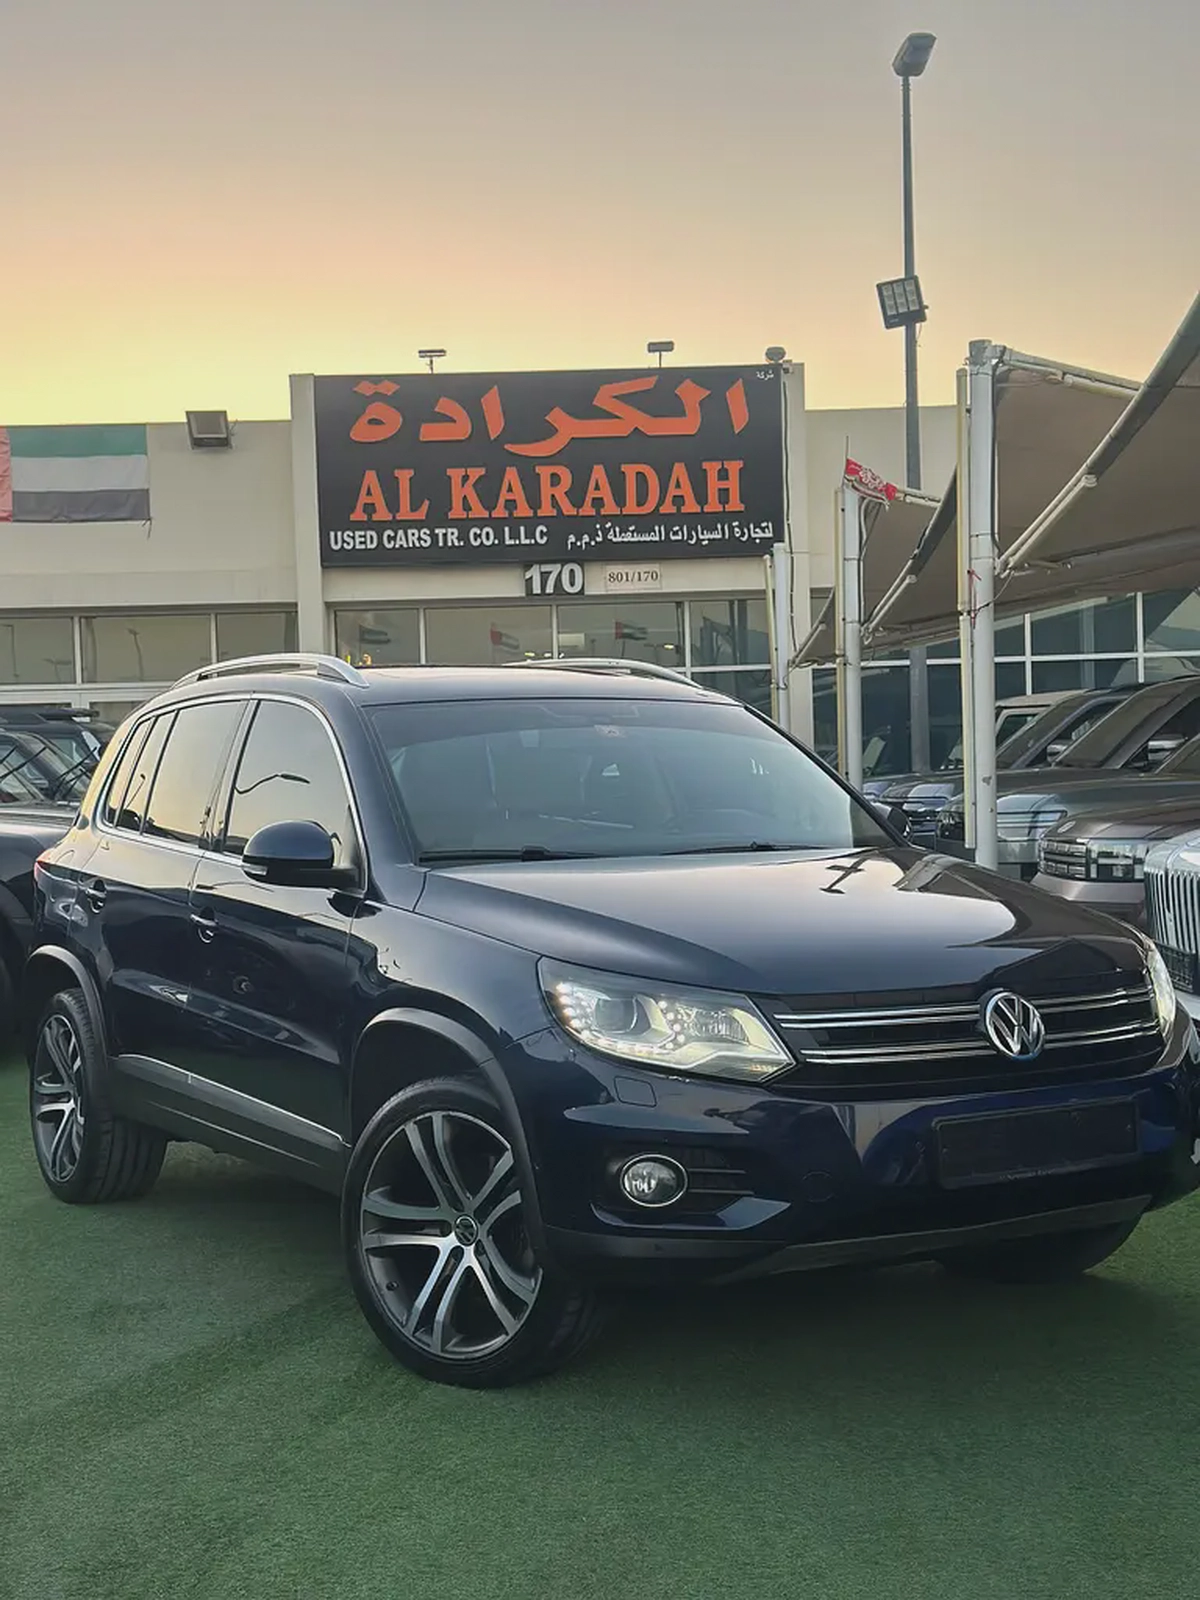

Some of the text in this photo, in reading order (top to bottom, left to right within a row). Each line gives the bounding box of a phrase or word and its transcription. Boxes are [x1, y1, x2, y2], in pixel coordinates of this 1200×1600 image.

[349, 376, 749, 457] الكرادة
[349, 462, 745, 522] AL KARADAH
[329, 525, 548, 550] USED CARS TR. CO. L.L.C
[606, 522, 665, 543] المستعملة
[669, 522, 729, 546] السيارات
[734, 521, 774, 544] لتجارة
[524, 562, 584, 595] 170
[608, 570, 659, 583] 801/170
[986, 991, 1044, 1059] VW
